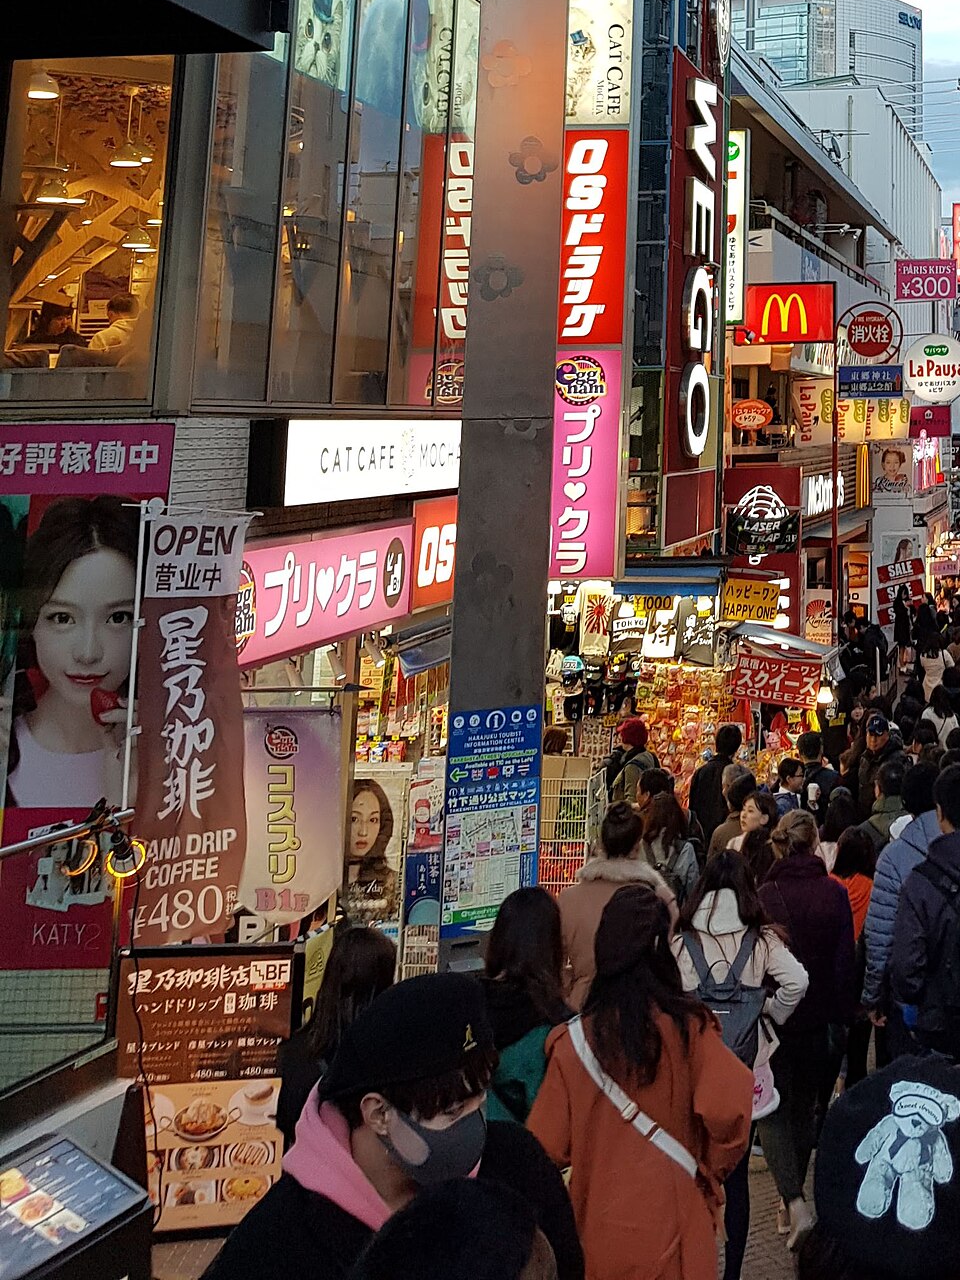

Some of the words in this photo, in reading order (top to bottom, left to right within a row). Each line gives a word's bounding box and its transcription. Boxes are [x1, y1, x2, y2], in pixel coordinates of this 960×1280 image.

[607, 23, 625, 62] CAT
[606, 66, 624, 116] CAFE
[561, 138, 608, 338] OSドラッグ
[681, 76, 717, 458] WEGO
[902, 263, 927, 274] PARIS
[928, 265, 951, 274] KID'S
[901, 276, 950, 297] ¥300
[851, 324, 890, 343] 消火栓
[556, 362, 598, 386] egg
[909, 359, 924, 377] La
[321, 446, 353, 474] CAT
[357, 444, 395, 472] CAFE
[743, 520, 781, 532] LASER
[153, 525, 238, 556] OPEN
[750, 532, 781, 543] TRAP
[155, 562, 222, 593] 营业中
[887, 561, 913, 577] SALE
[635, 596, 672, 611] ¥1000
[726, 585, 778, 601] ハッピーワン
[723, 602, 755, 619] HAPPY
[756, 605, 776, 620] ONE
[740, 657, 819, 677] 原宿ハッピーワン
[737, 669, 819, 696] スクイーズ
[735, 686, 817, 705] SQUEEZE
[464, 739, 503, 748] INFORMATION
[503, 736, 524, 744] CENTER
[468, 733, 497, 742] HARAJUKU
[499, 730, 522, 739] TOURIST
[448, 789, 537, 807] 竹下通り公式マップ
[267, 764, 302, 884] コスプリ
[145, 836, 181, 863] AND
[185, 828, 238, 856] DRIP
[145, 856, 219, 890] COFFEE
[255, 887, 310, 913] B1F
[130, 884, 224, 940] ¥480
[265, 963, 288, 980] BF
[135, 995, 222, 1014] ハンドドリップ
[238, 991, 279, 1012] 珈琲
